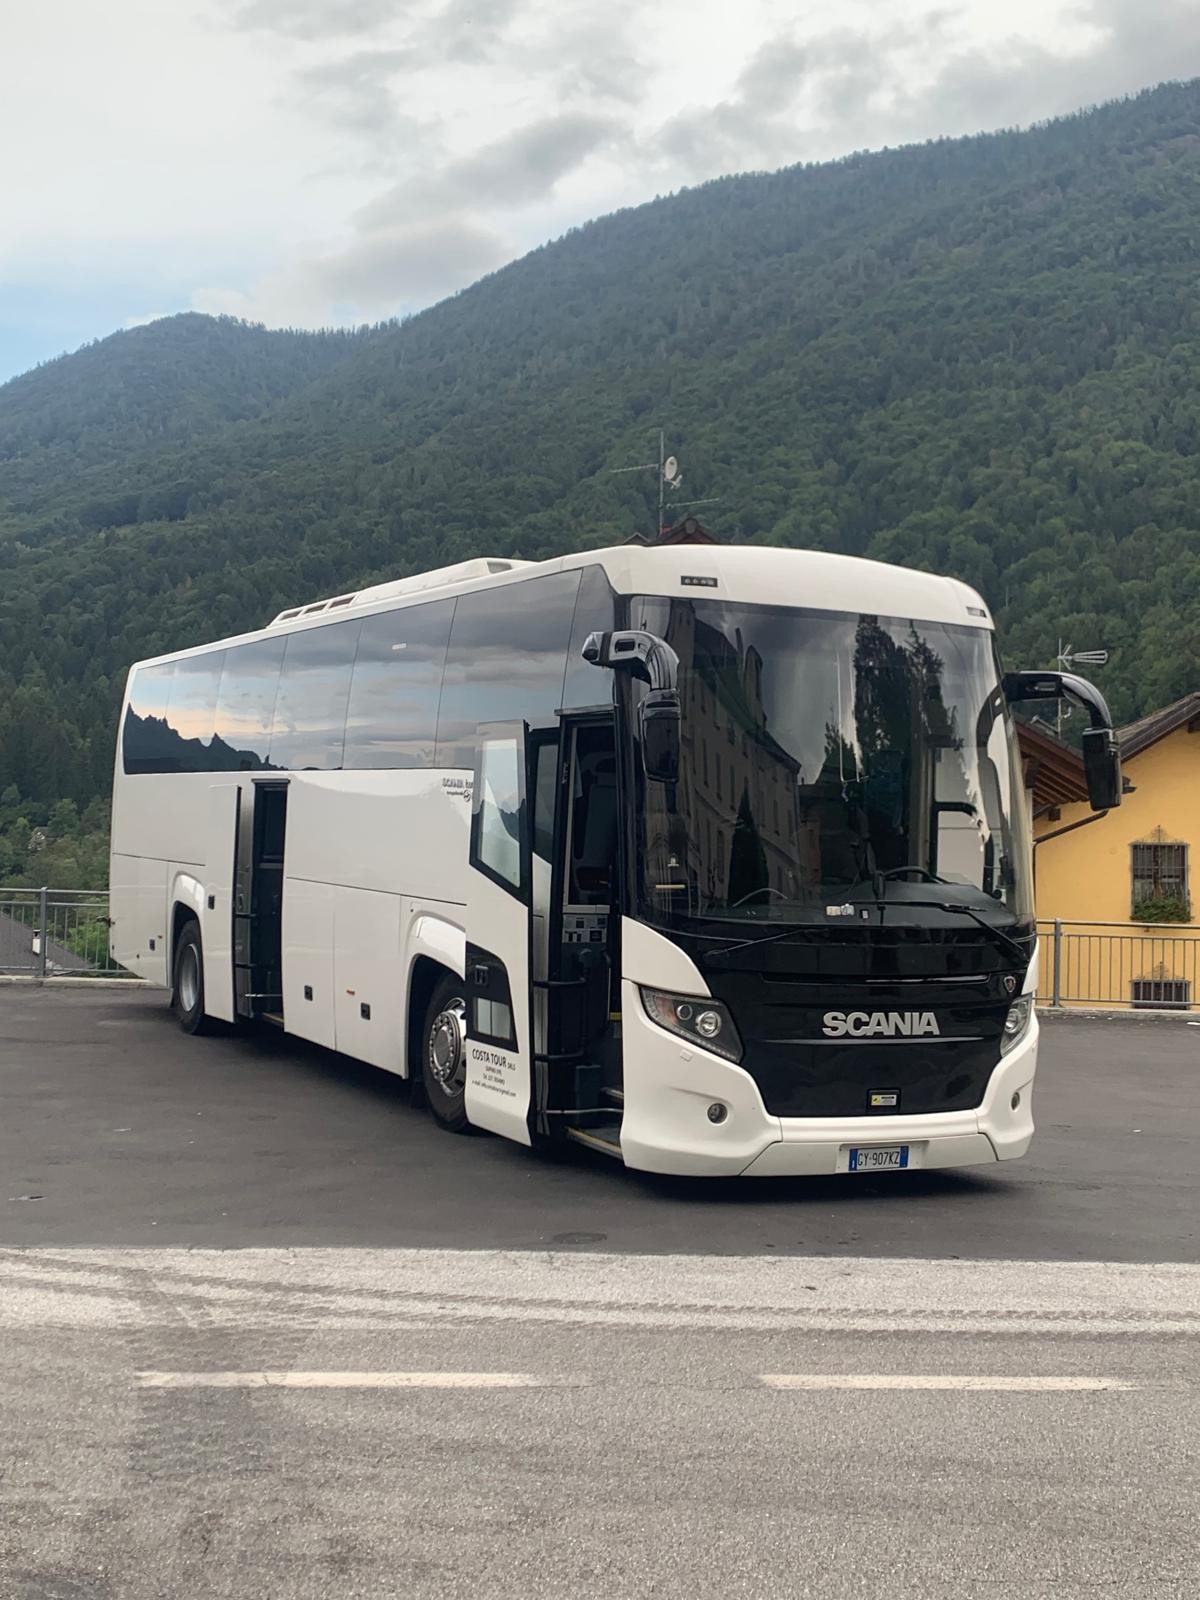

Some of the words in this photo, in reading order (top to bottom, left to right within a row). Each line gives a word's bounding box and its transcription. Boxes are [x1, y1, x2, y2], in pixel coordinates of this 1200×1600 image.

[822, 1011, 940, 1037] SCANIA
[472, 1048, 490, 1062] COSTA
[490, 1053, 507, 1068] TOUR
